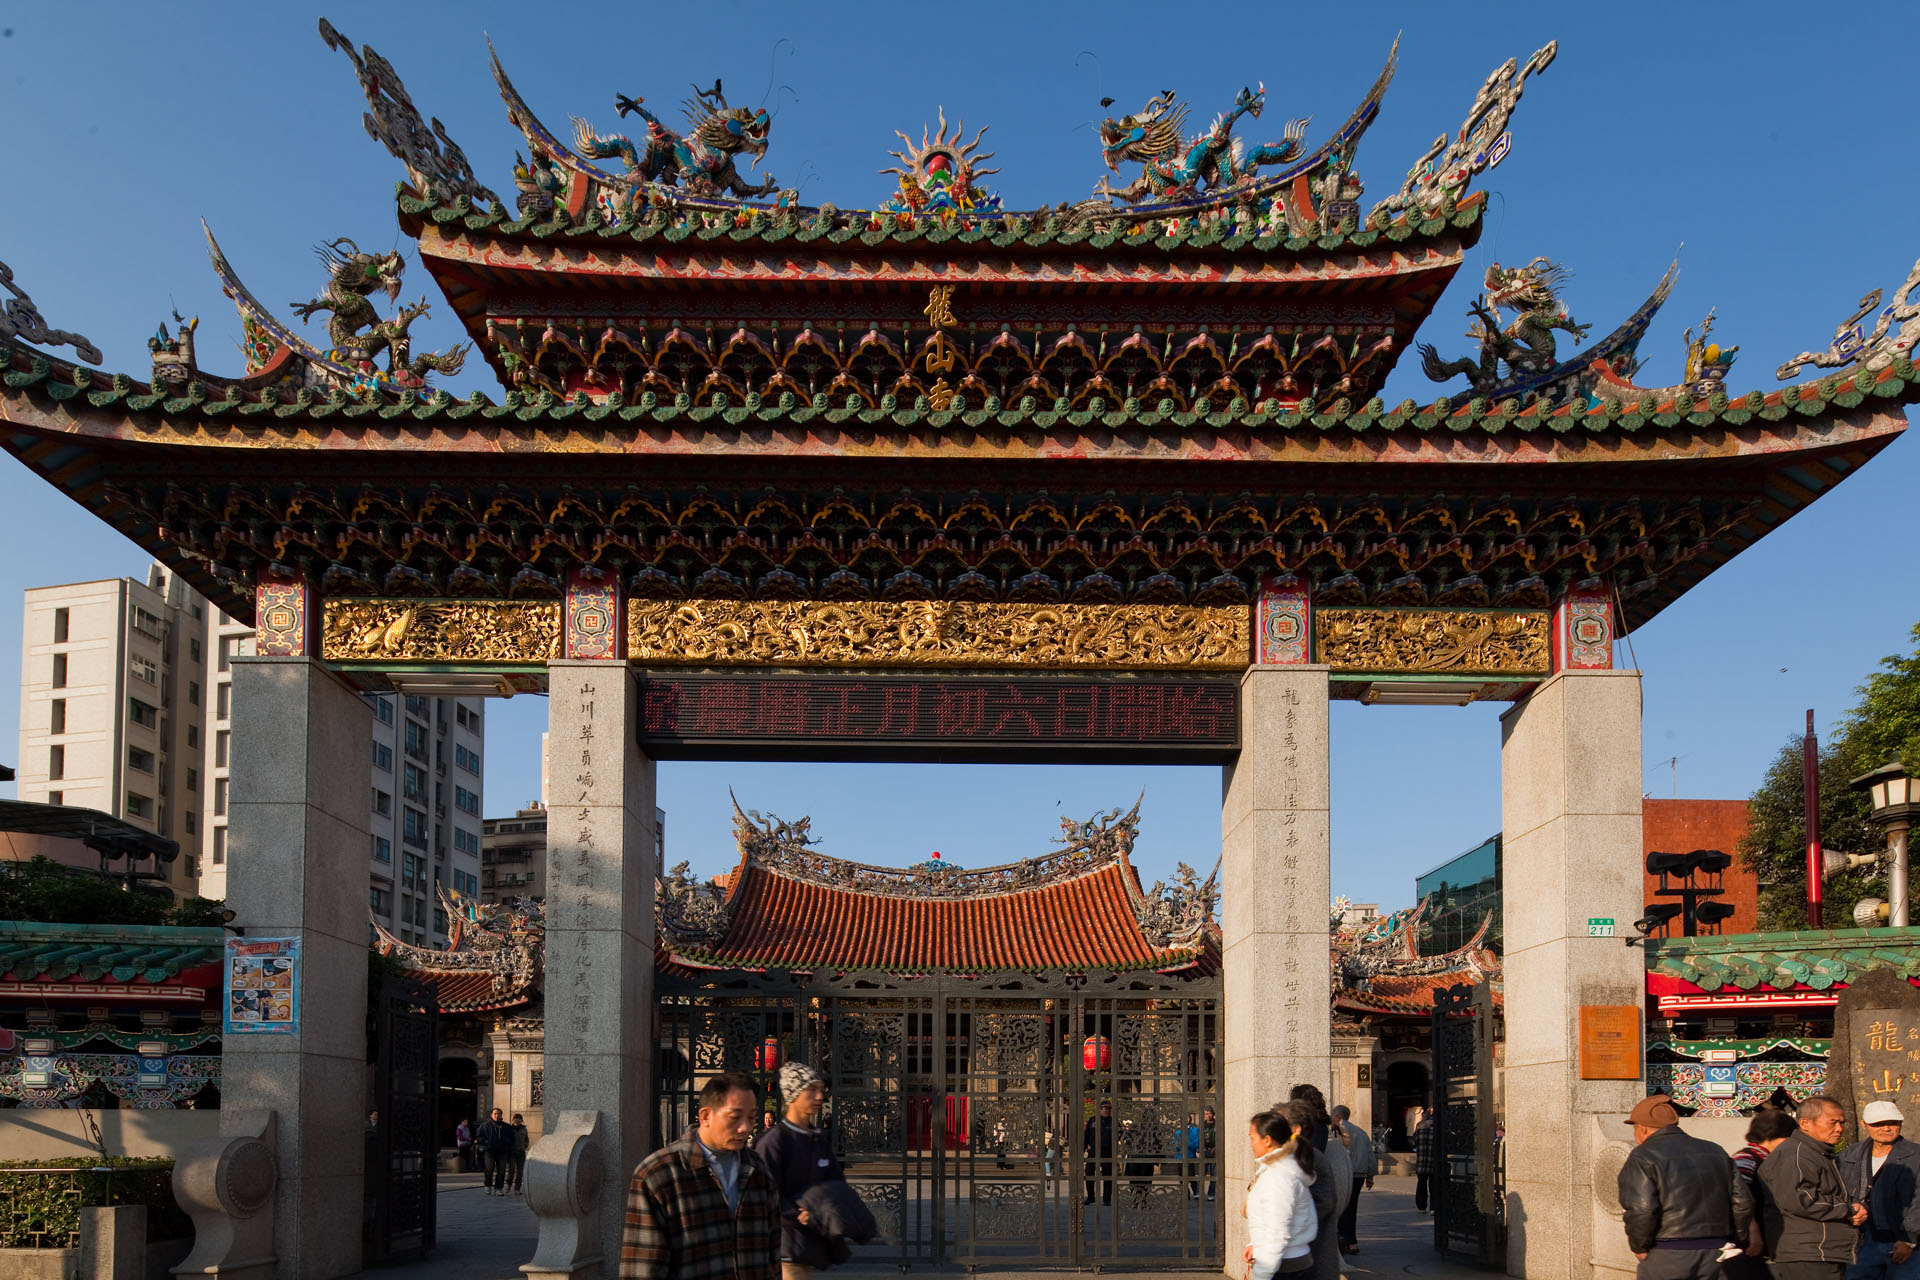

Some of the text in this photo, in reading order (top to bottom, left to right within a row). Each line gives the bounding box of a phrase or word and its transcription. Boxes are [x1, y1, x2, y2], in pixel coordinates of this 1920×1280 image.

[924, 284, 958, 411] 龍山寺
[644, 680, 1235, 740] 於農曆正月初六日開始
[1590, 926, 1612, 935] 211
[1865, 1020, 1905, 1093] 龍山
